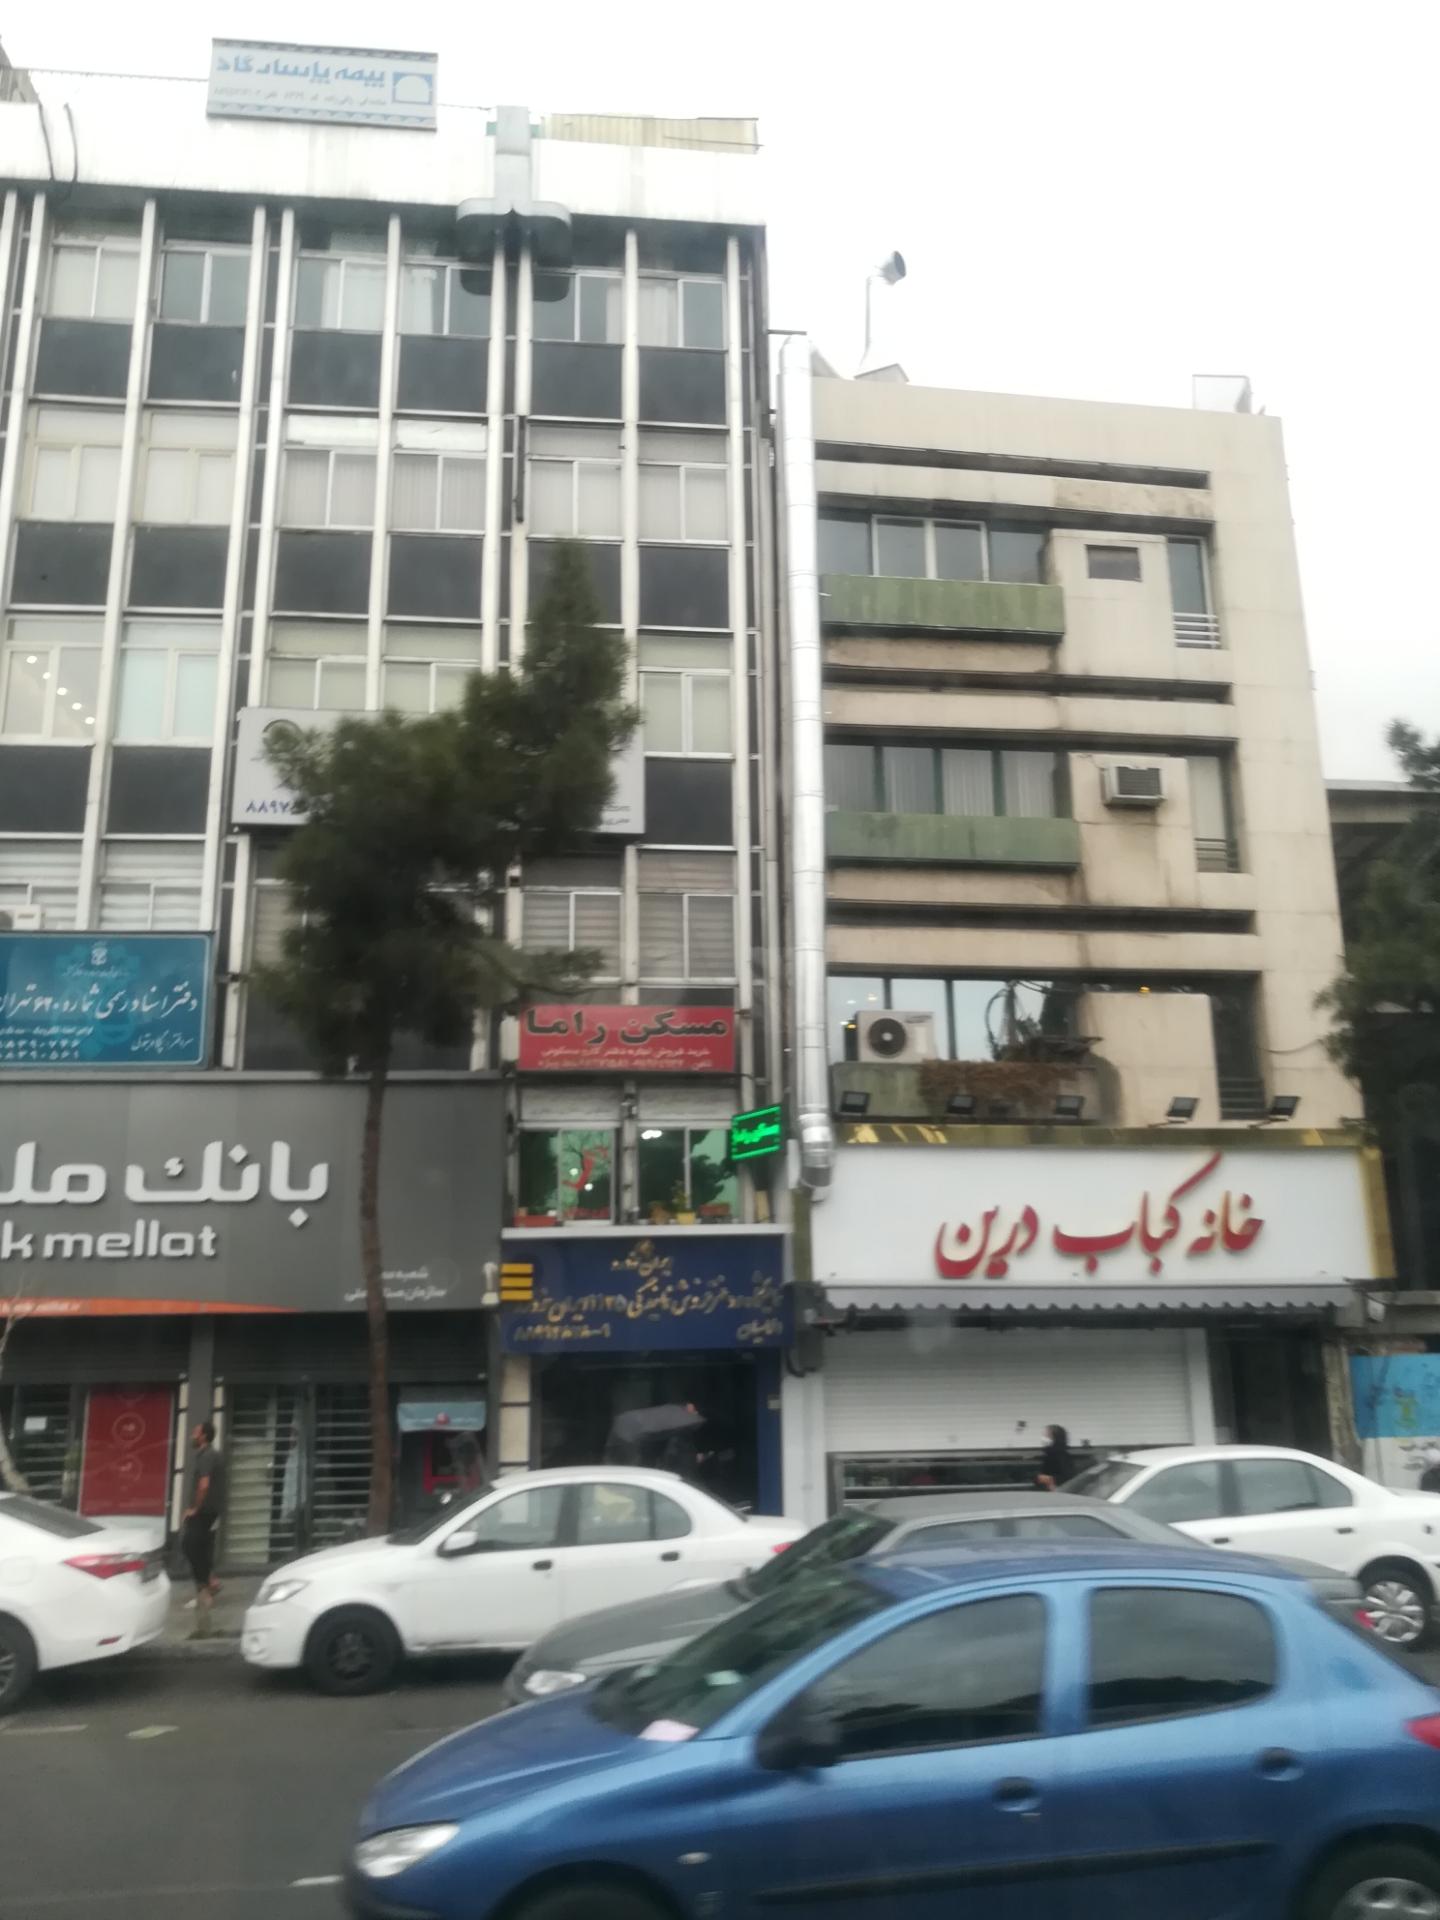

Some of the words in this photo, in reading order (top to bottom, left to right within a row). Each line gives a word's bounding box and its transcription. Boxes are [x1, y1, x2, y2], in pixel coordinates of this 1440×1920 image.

[217, 55, 331, 84] پاسارگاد
[526, 1007, 608, 1046] راما
[619, 1008, 728, 1045] مسکن
[0, 1140, 108, 1204] مل
[124, 1140, 329, 1228] بانک
[42, 1218, 217, 1259] mellat
[1052, 1150, 1223, 1276] کباب
[1186, 1189, 1265, 1258] خانه
